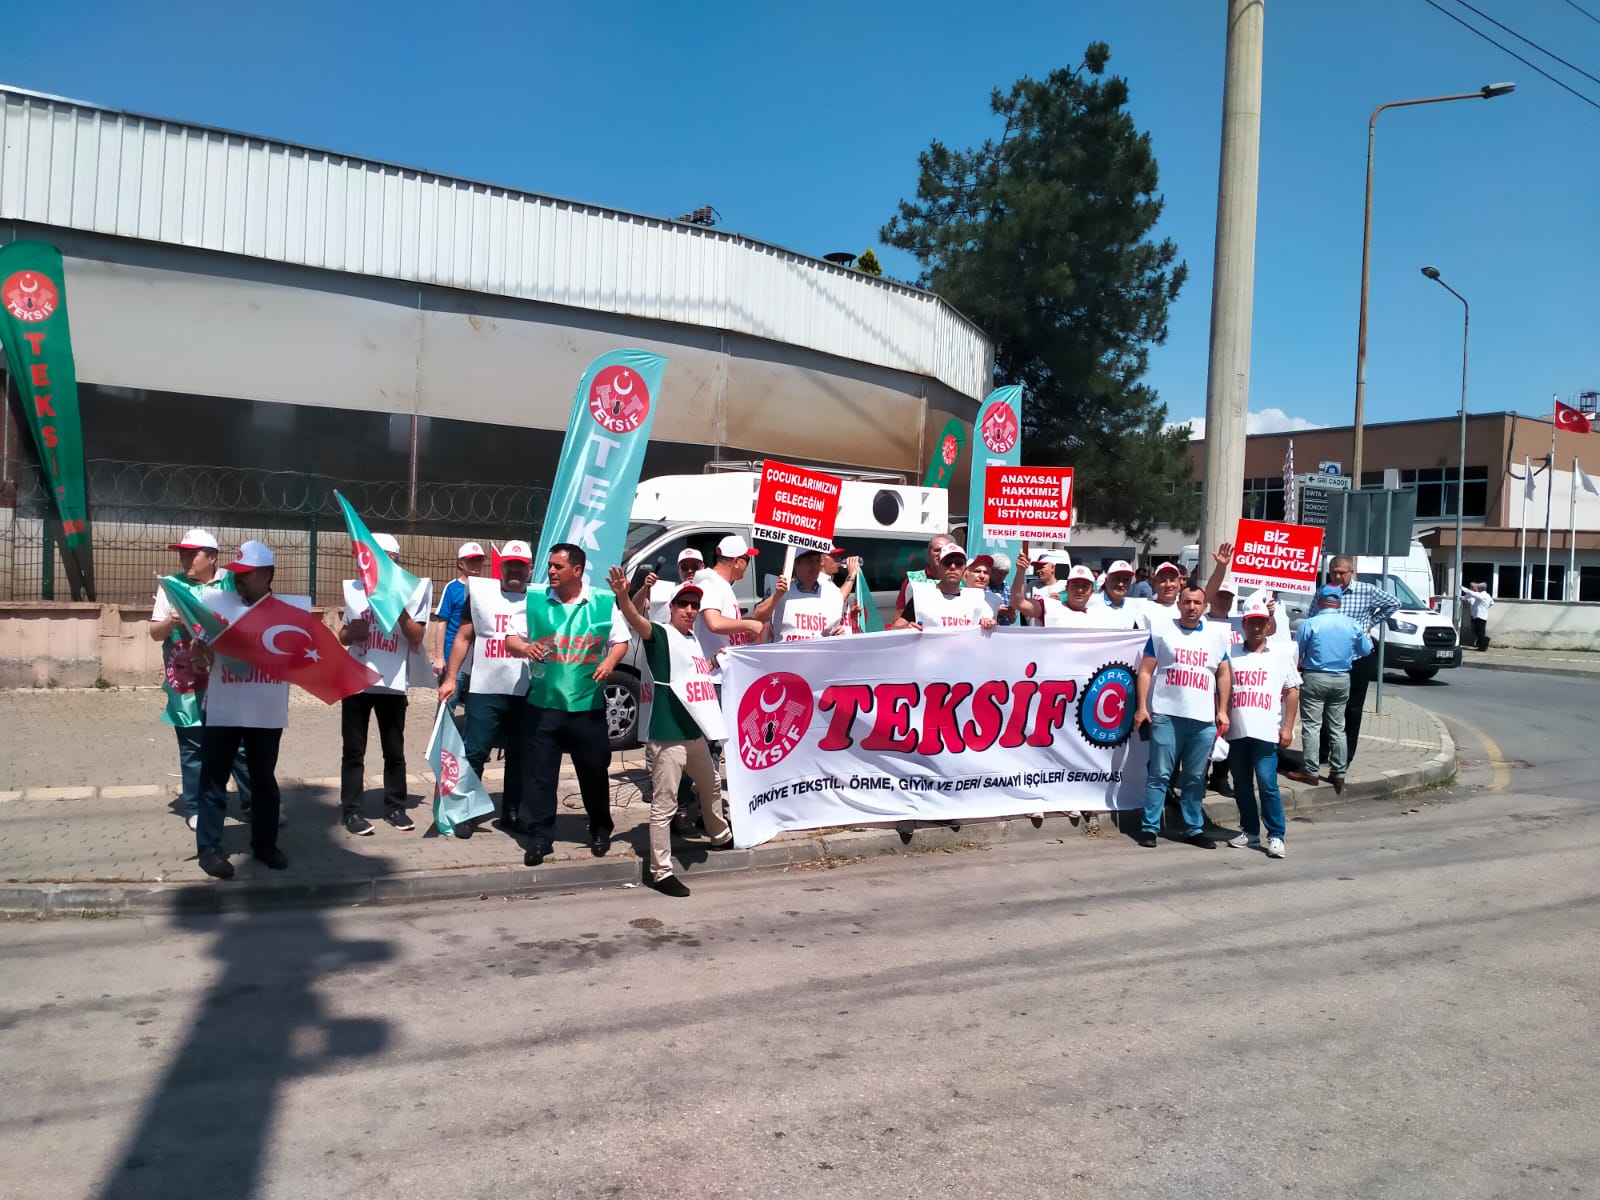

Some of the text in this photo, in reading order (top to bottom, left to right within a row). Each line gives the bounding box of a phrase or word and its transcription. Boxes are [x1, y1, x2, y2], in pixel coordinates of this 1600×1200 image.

[23, 332, 64, 500] TEKSİ
[590, 397, 640, 432] TEKSİF
[983, 430, 1014, 453] TEKSİF
[766, 468, 838, 496] ÇOCUKLARIMIZIN
[1000, 474, 1059, 485] ANAYASAL
[775, 490, 825, 512] GELECEĞİNİ
[1002, 486, 1059, 497] HAKKIMIZ
[987, 497, 1059, 508] KULLANMAK
[772, 507, 817, 530] İSTİYORUZ
[997, 507, 1058, 520] İSTİYORUZ
[754, 527, 831, 552] TEKSİF SENDİKASI
[987, 529, 1066, 539] TEKSİF SENDİKASI
[1264, 529, 1290, 544] BİZ
[1243, 541, 1306, 559] BİRLİKTE
[1235, 554, 1309, 573] GÜÇLÜYÜZ
[1233, 576, 1311, 592] TEKSİF SENDİKASI
[795, 612, 827, 632] TEKSİF
[1174, 647, 1209, 668] TEKSİF
[1165, 667, 1210, 692] SENDİKASI
[1234, 667, 1268, 687] TEKSİF
[818, 661, 1077, 756] TEKSİF
[1232, 687, 1272, 711] ENDİKASI
[740, 724, 801, 768] TEKSİF
[748, 768, 1122, 815] TÜRKİYE TEKSTİL, ÖRME, GİYİM VE DERİ SANAYİ İŞÇİLERİ SENDİKASI
